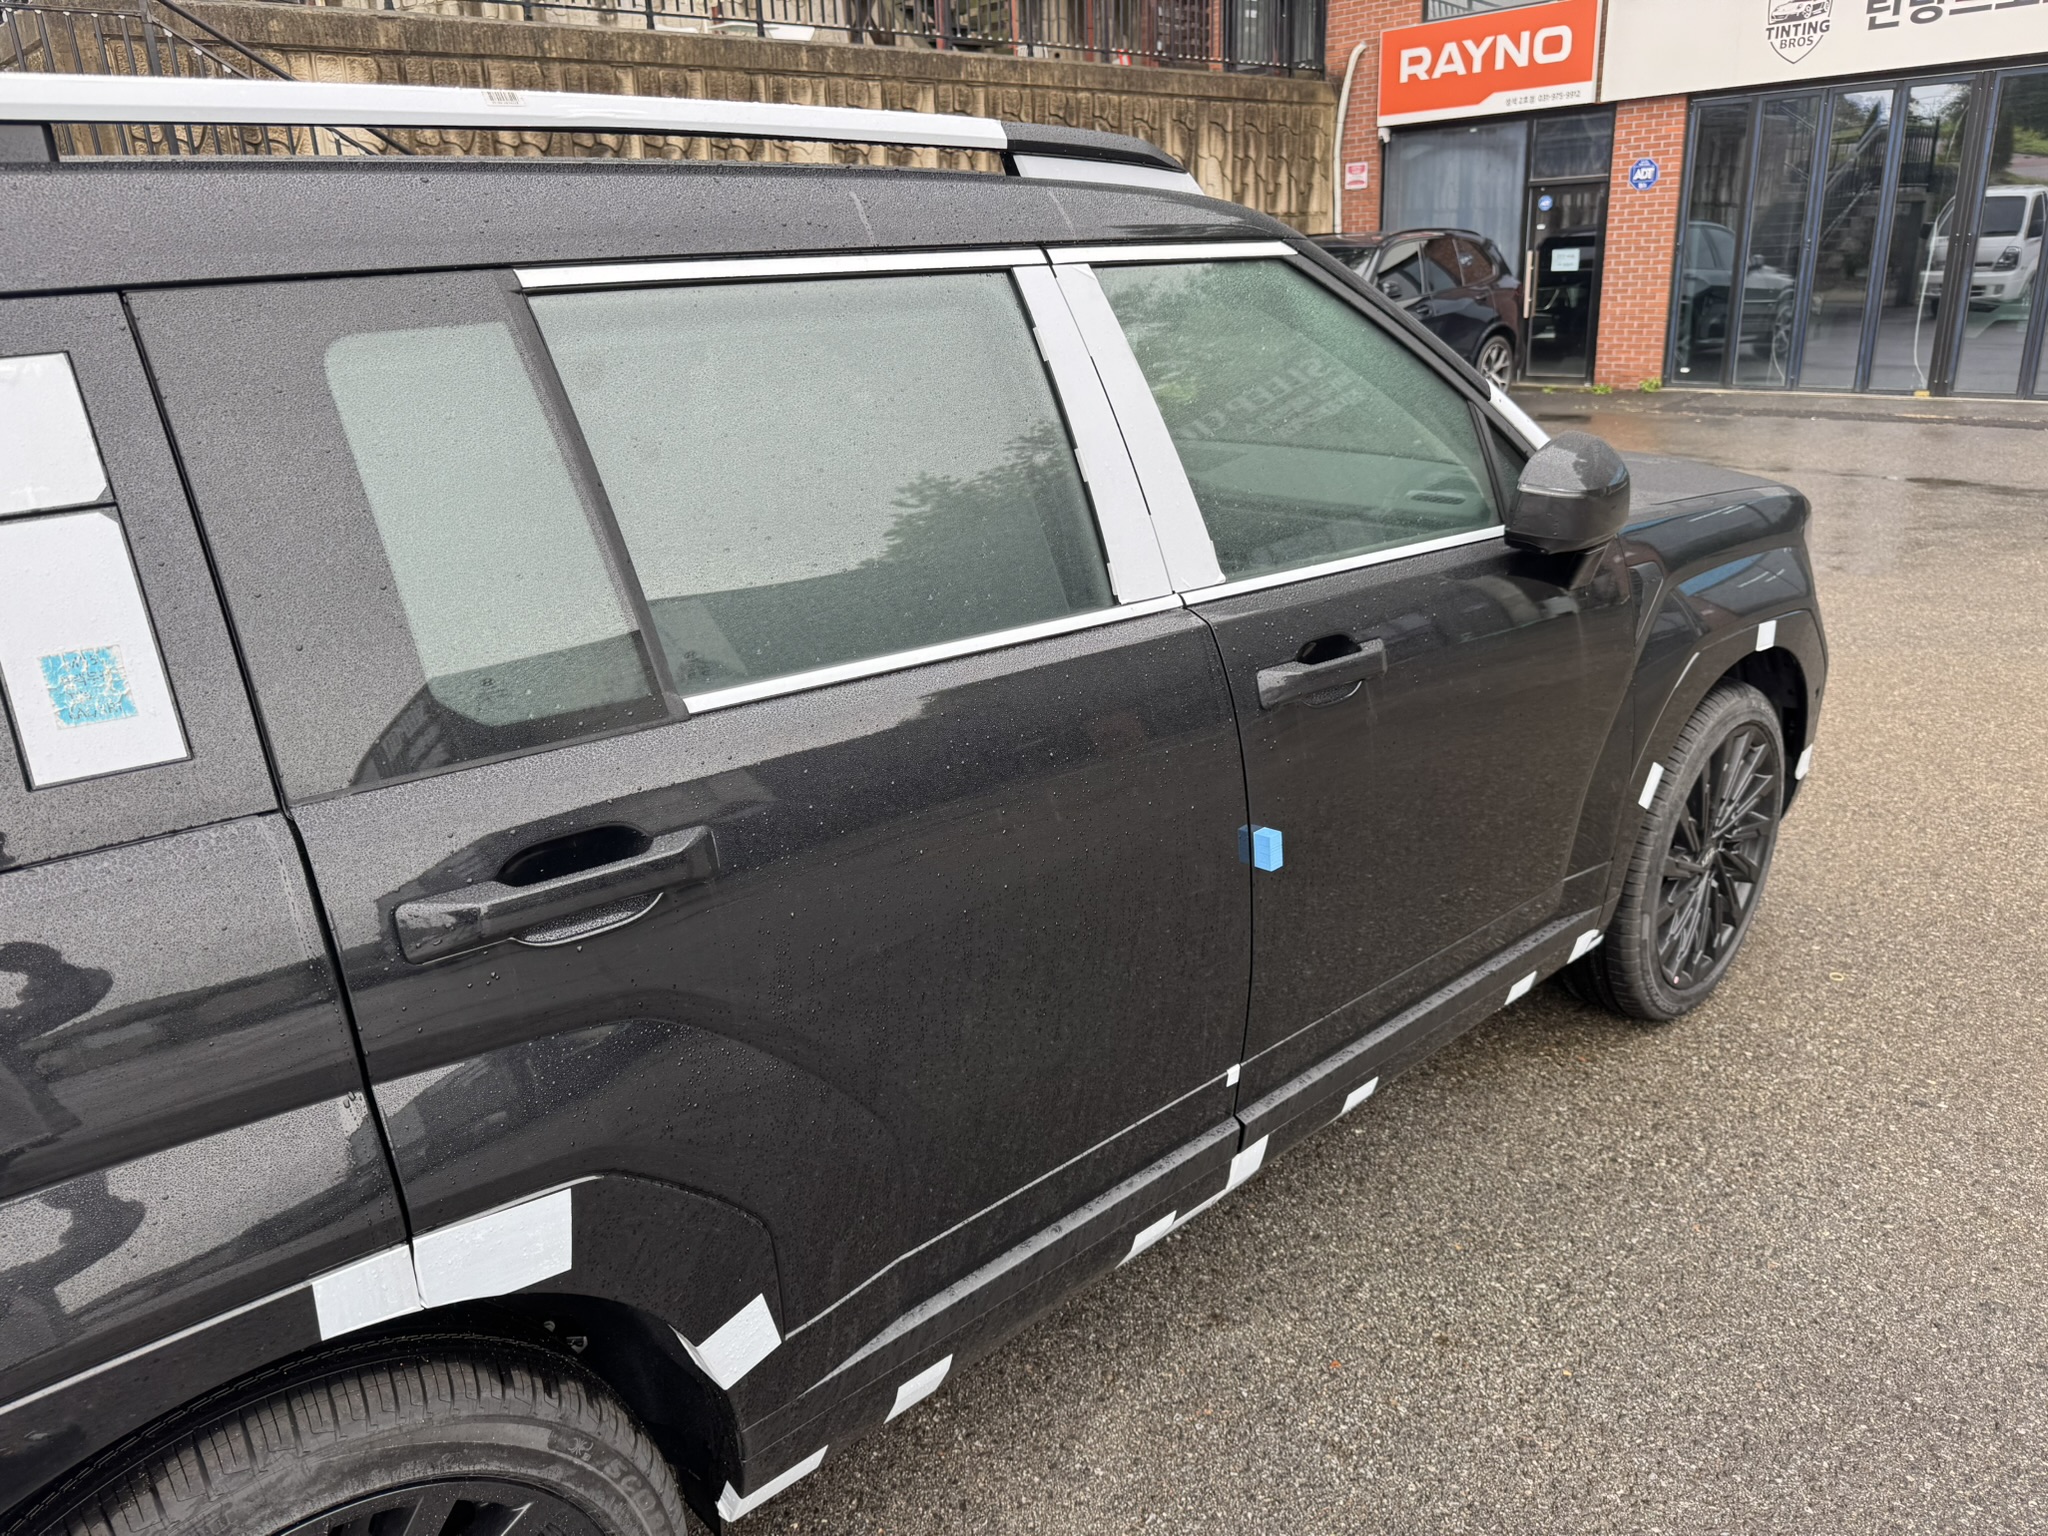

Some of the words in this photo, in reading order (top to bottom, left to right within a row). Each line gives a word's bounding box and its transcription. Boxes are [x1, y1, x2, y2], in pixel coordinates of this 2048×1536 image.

[1766, 20, 1830, 40] TINTING
[1780, 36, 1813, 49] BROS
[1399, 25, 1573, 83] RAYNO
[1633, 168, 1655, 180] ADT
[603, 1458, 670, 1536] SCOR
